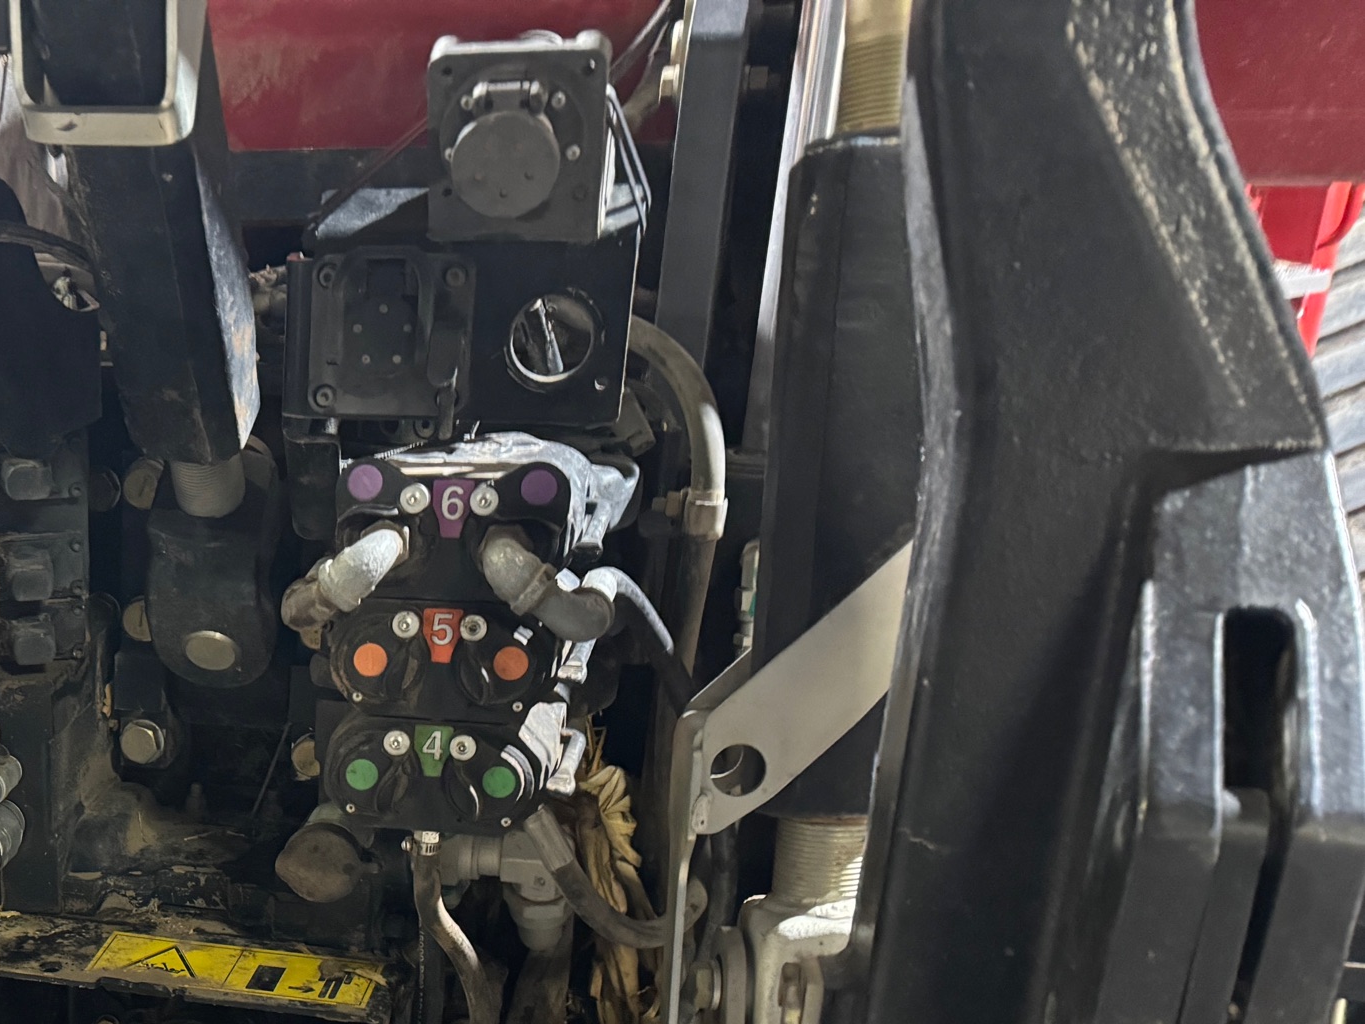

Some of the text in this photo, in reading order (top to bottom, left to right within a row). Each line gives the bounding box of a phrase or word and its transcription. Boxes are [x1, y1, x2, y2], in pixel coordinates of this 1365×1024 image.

[441, 486, 464, 520] 6
[431, 613, 453, 645] 5
[422, 730, 443, 761] 4
